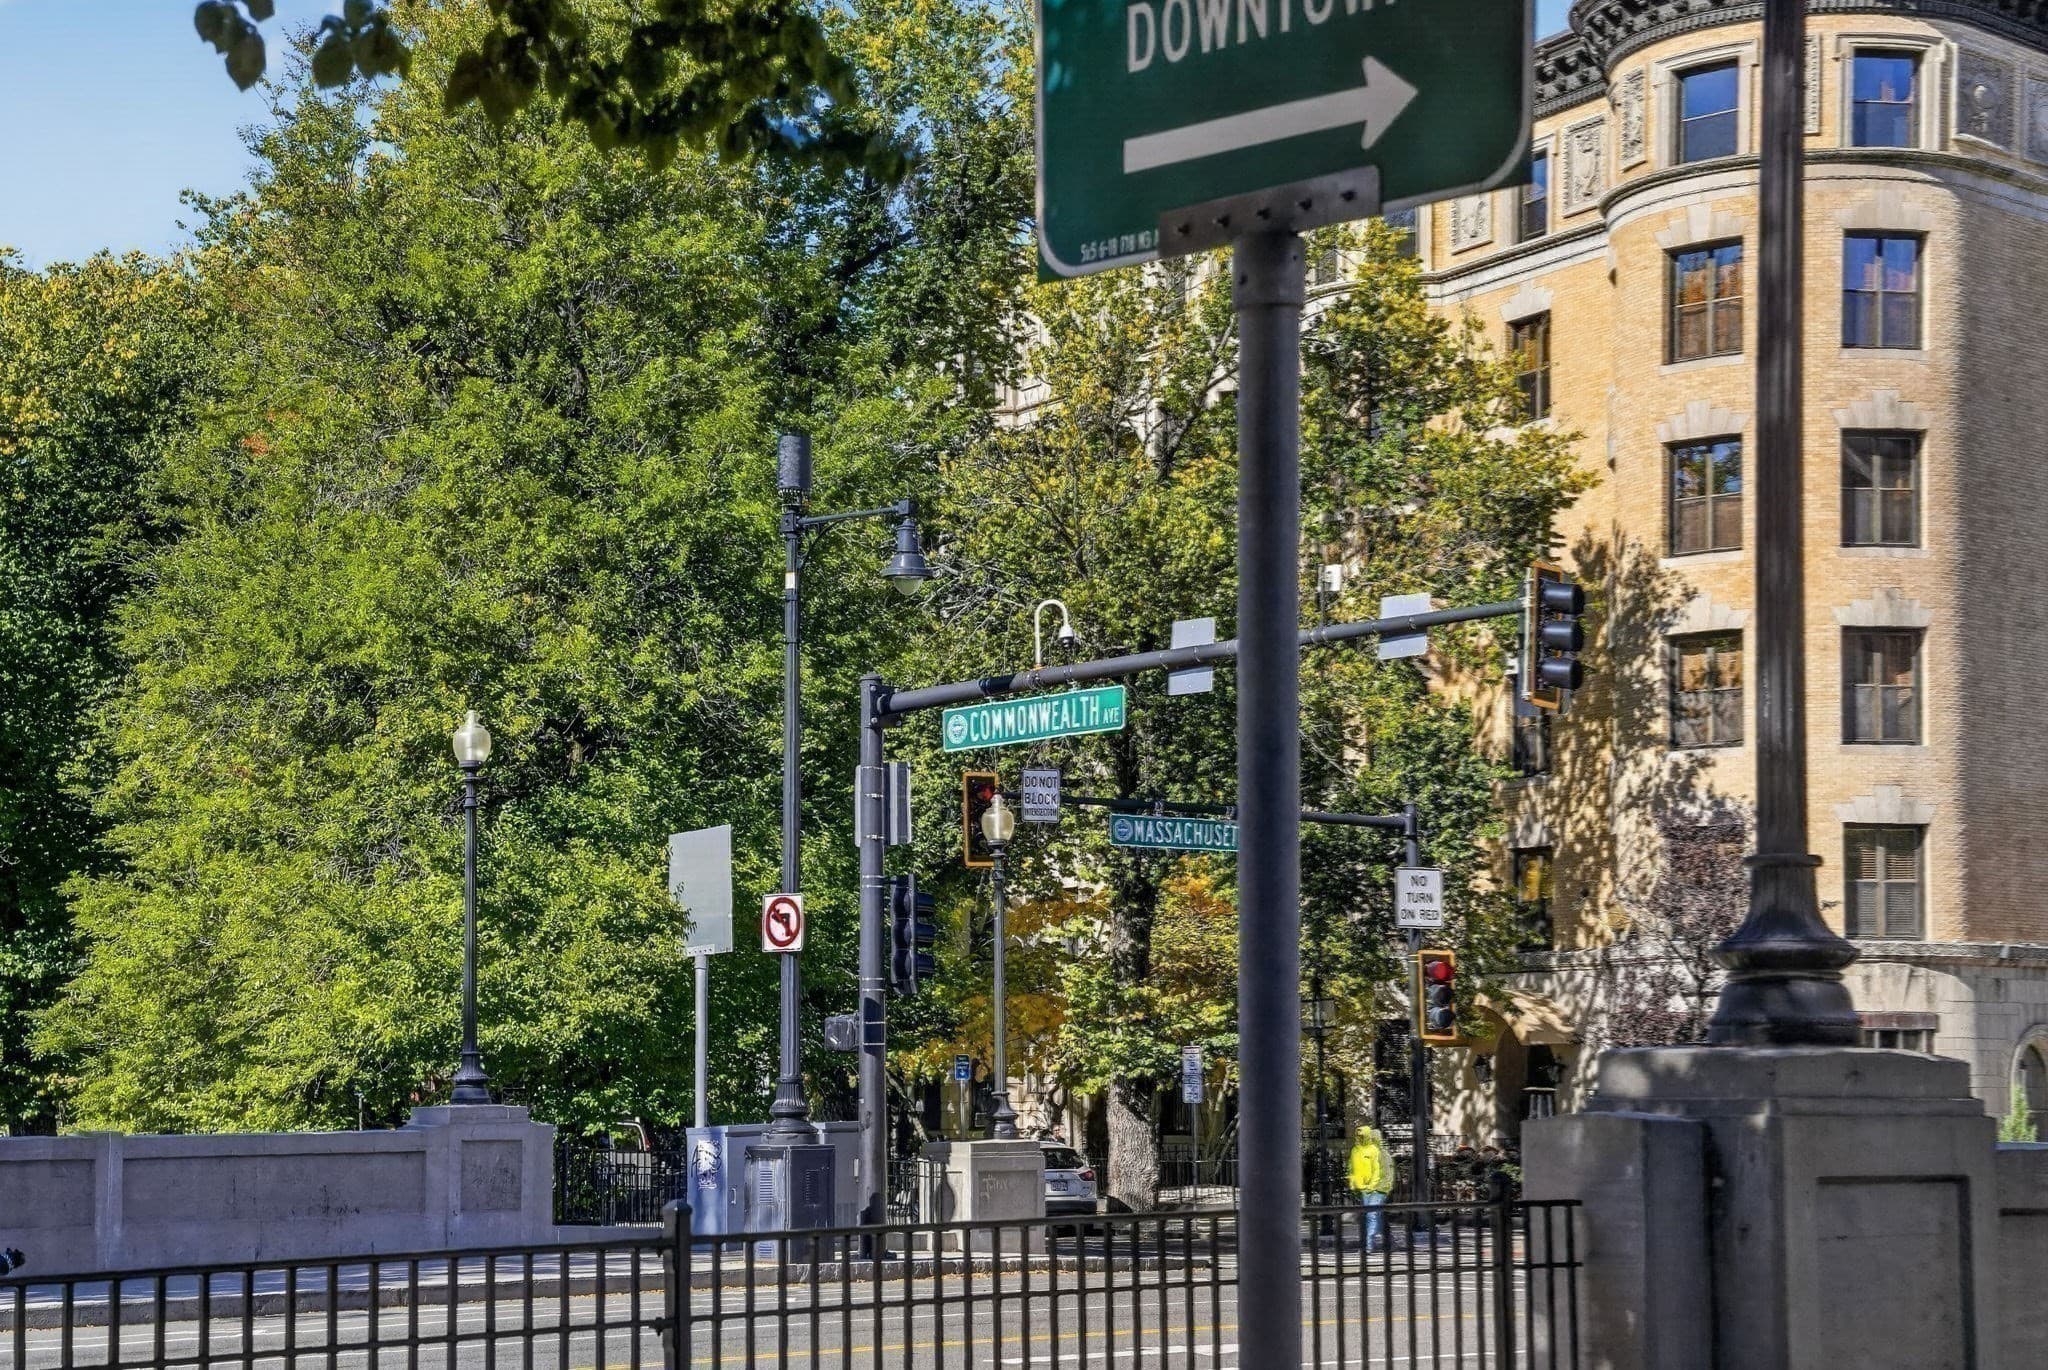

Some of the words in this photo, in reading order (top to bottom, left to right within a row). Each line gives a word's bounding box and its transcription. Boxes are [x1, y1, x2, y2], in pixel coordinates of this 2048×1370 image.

[1127, 0, 1396, 73] DOWN
[969, 694, 1100, 742] COMMONWEALTH
[1102, 706, 1120, 725] AVE
[1024, 776, 1037, 788] DO
[1039, 776, 1057, 789] NOT
[1024, 792, 1057, 805] BLOCK
[1134, 820, 1240, 847] MASSACHUSET
[1410, 875, 1427, 887] NO
[1405, 892, 1433, 904] TURN
[1400, 908, 1415, 920] ON
[1419, 908, 1440, 921] RED
